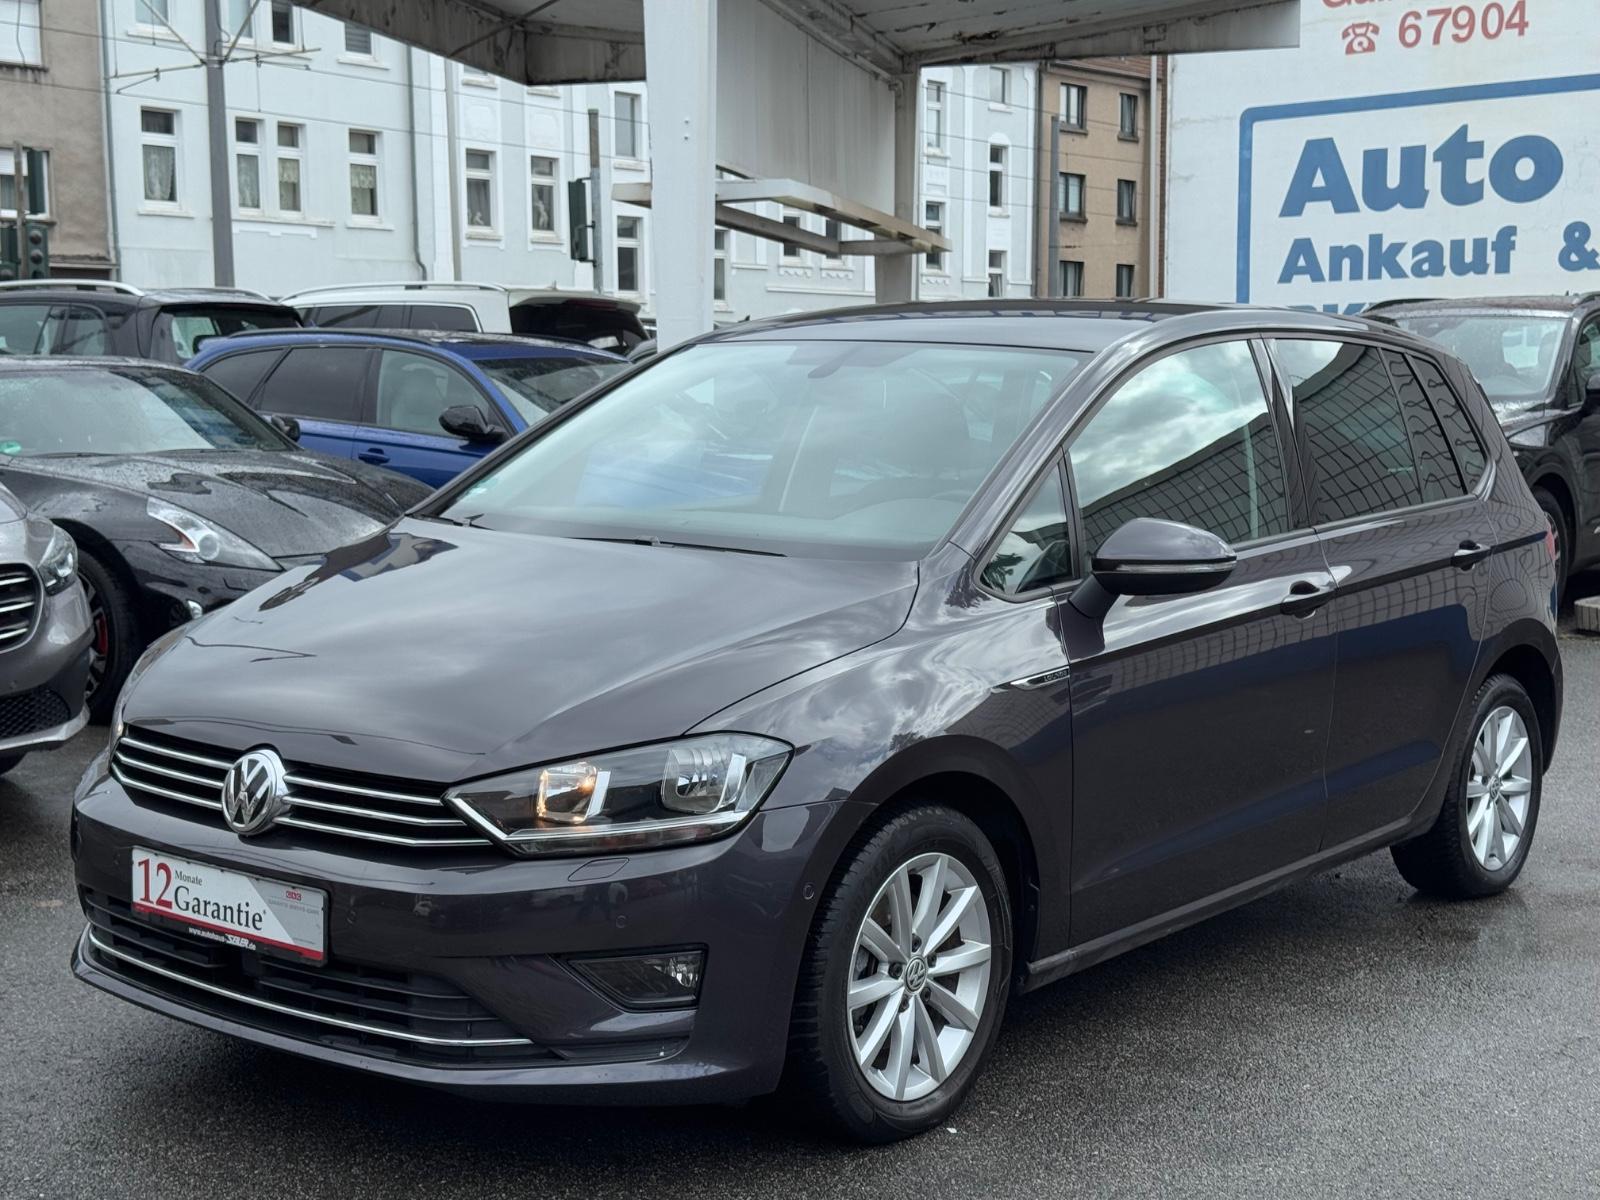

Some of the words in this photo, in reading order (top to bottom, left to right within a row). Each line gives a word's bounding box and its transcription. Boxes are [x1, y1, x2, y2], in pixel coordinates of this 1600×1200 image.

[1398, 0, 1529, 48] 67904
[1278, 124, 1563, 218] Auto
[1277, 225, 1517, 284] Ankauf
[1558, 221, 1600, 272] &
[138, 858, 173, 910] 12
[174, 870, 203, 886] Monate
[174, 885, 263, 931] Garantie
